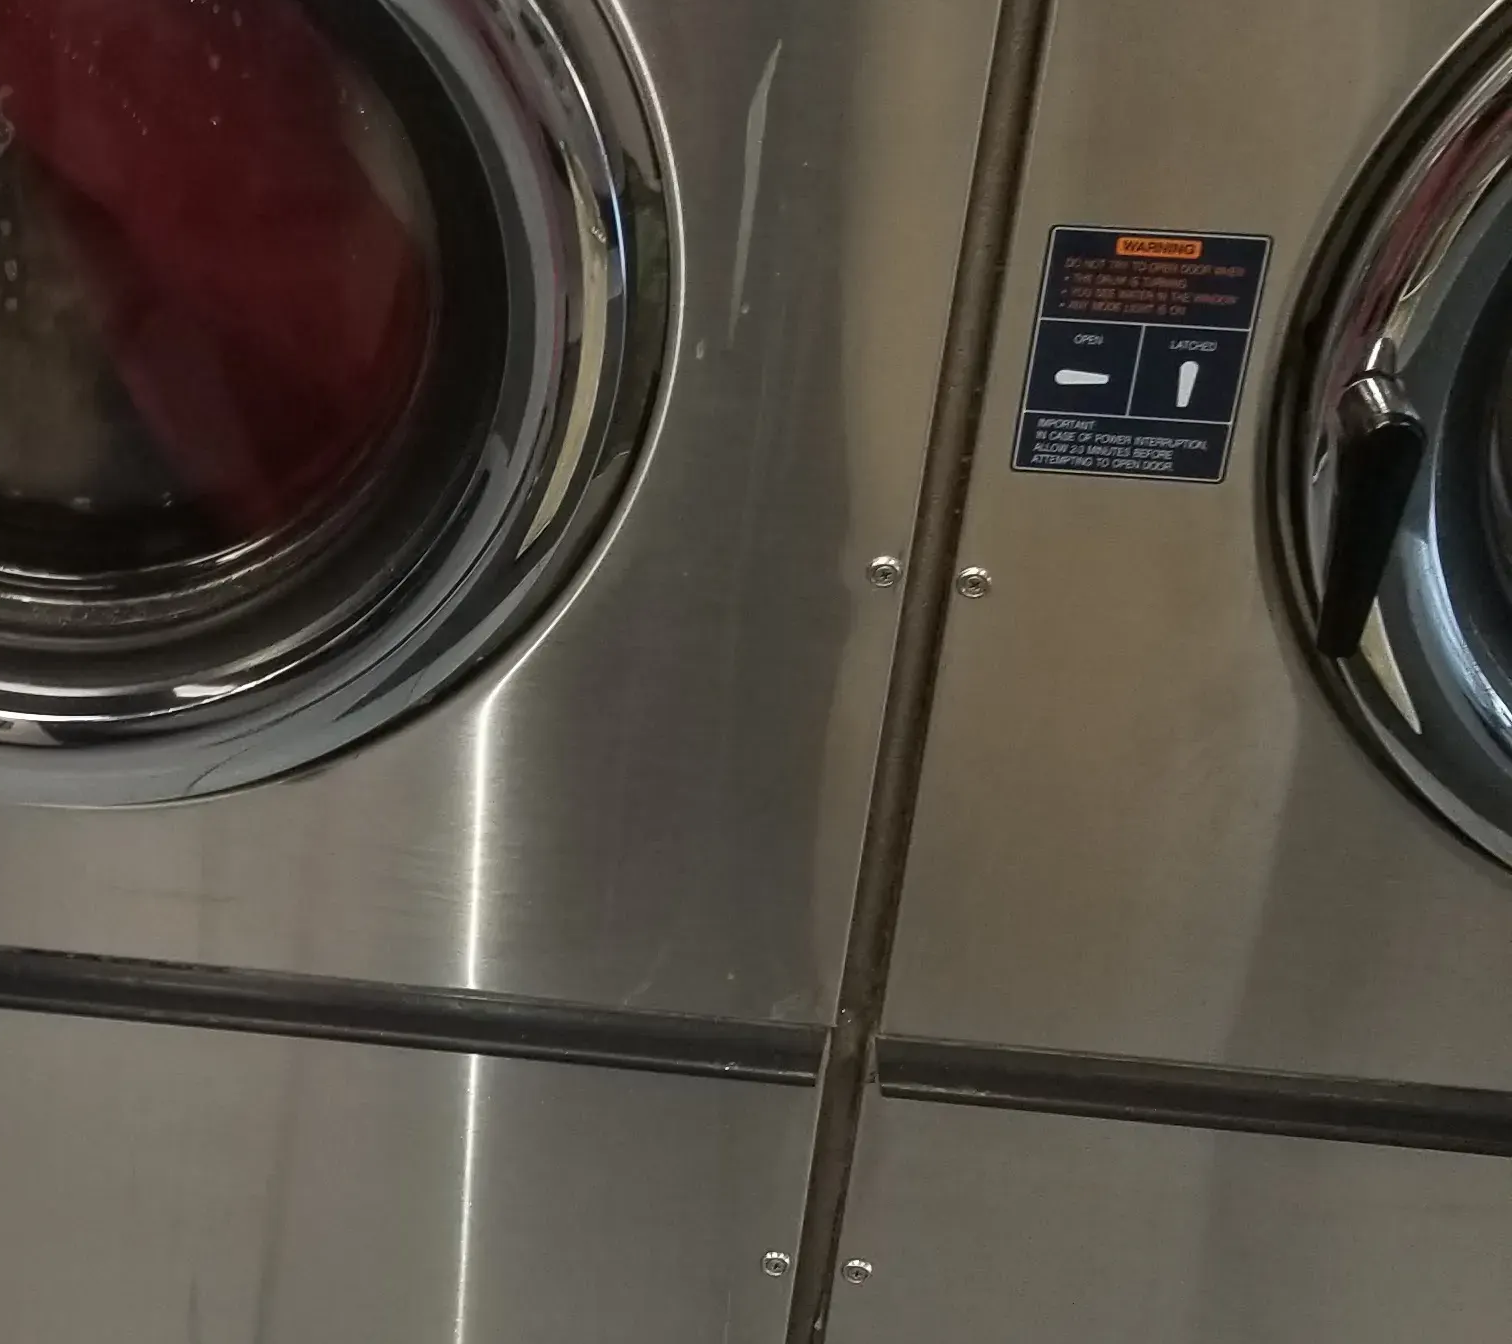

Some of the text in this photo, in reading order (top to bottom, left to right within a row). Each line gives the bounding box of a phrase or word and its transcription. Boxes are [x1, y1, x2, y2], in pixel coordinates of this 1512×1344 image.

[1122, 239, 1197, 256] WARNING
[1073, 333, 1104, 346] OPEN
[1168, 340, 1218, 352] LATCHED
